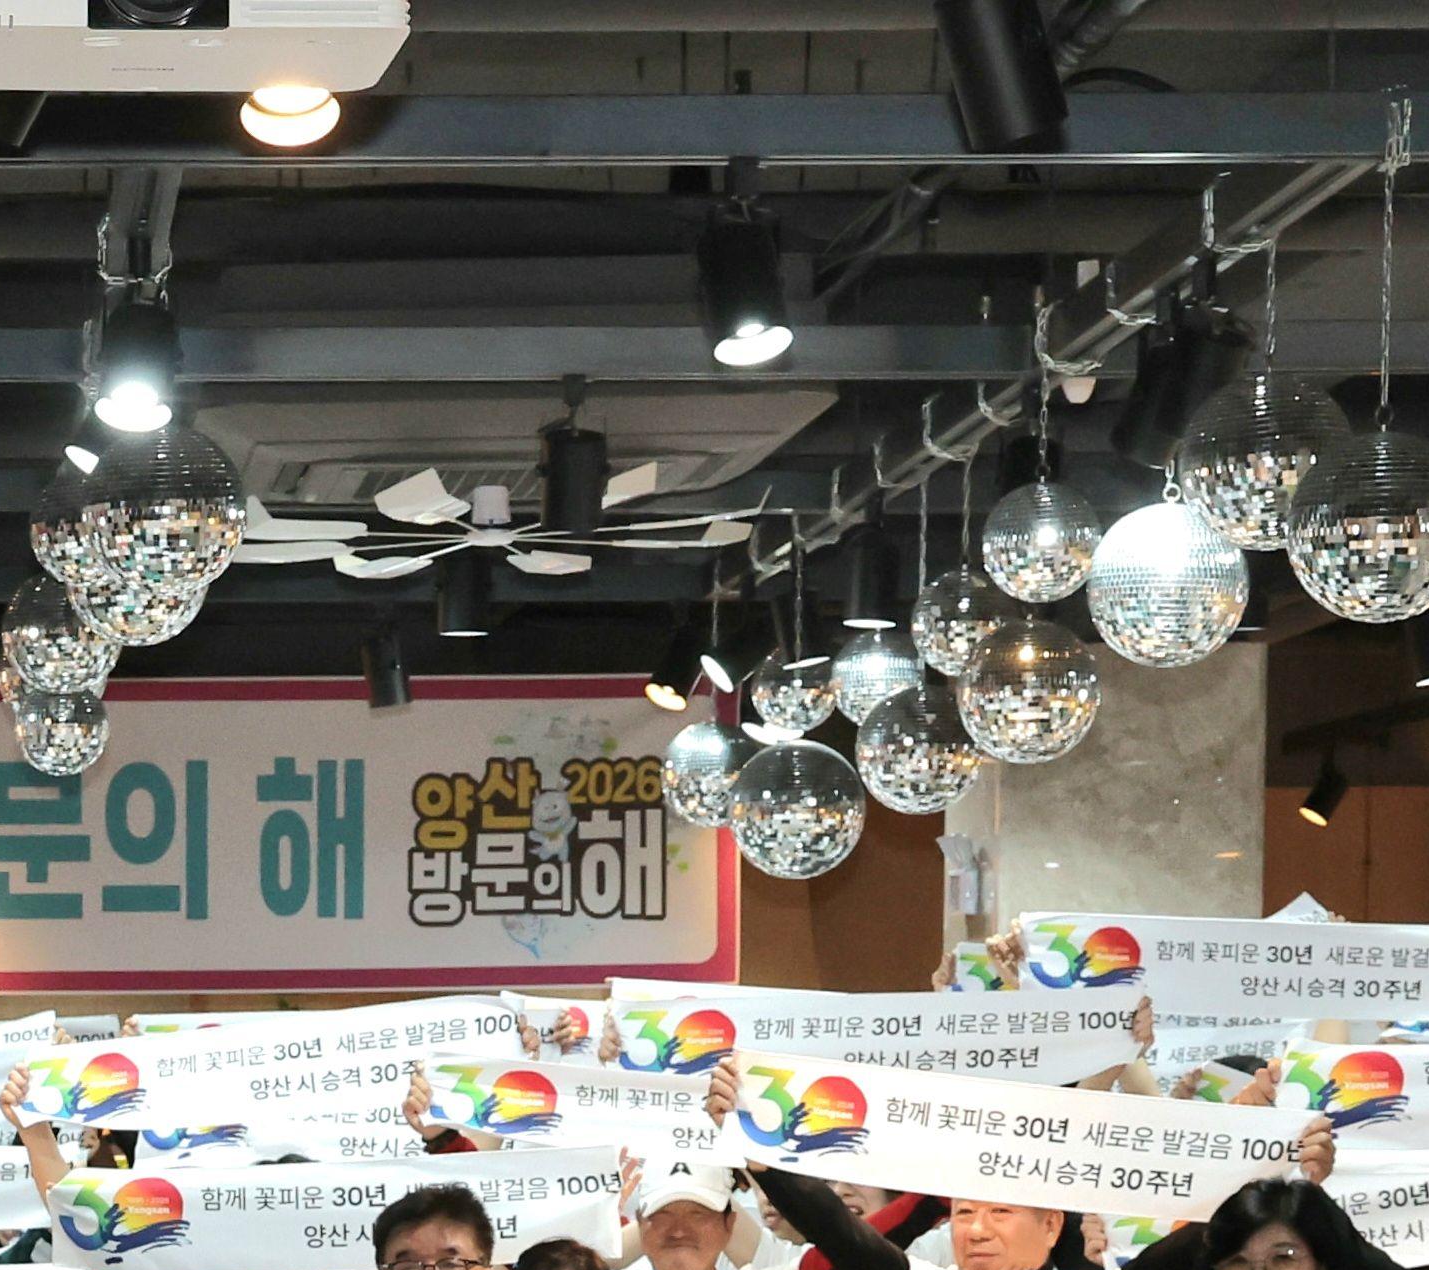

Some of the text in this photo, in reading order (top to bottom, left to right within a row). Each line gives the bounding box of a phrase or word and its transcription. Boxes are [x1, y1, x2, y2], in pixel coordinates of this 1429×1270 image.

[256, 754, 364, 923] 해
[412, 756, 663, 850] 양산 2026
[577, 808, 666, 919] 해
